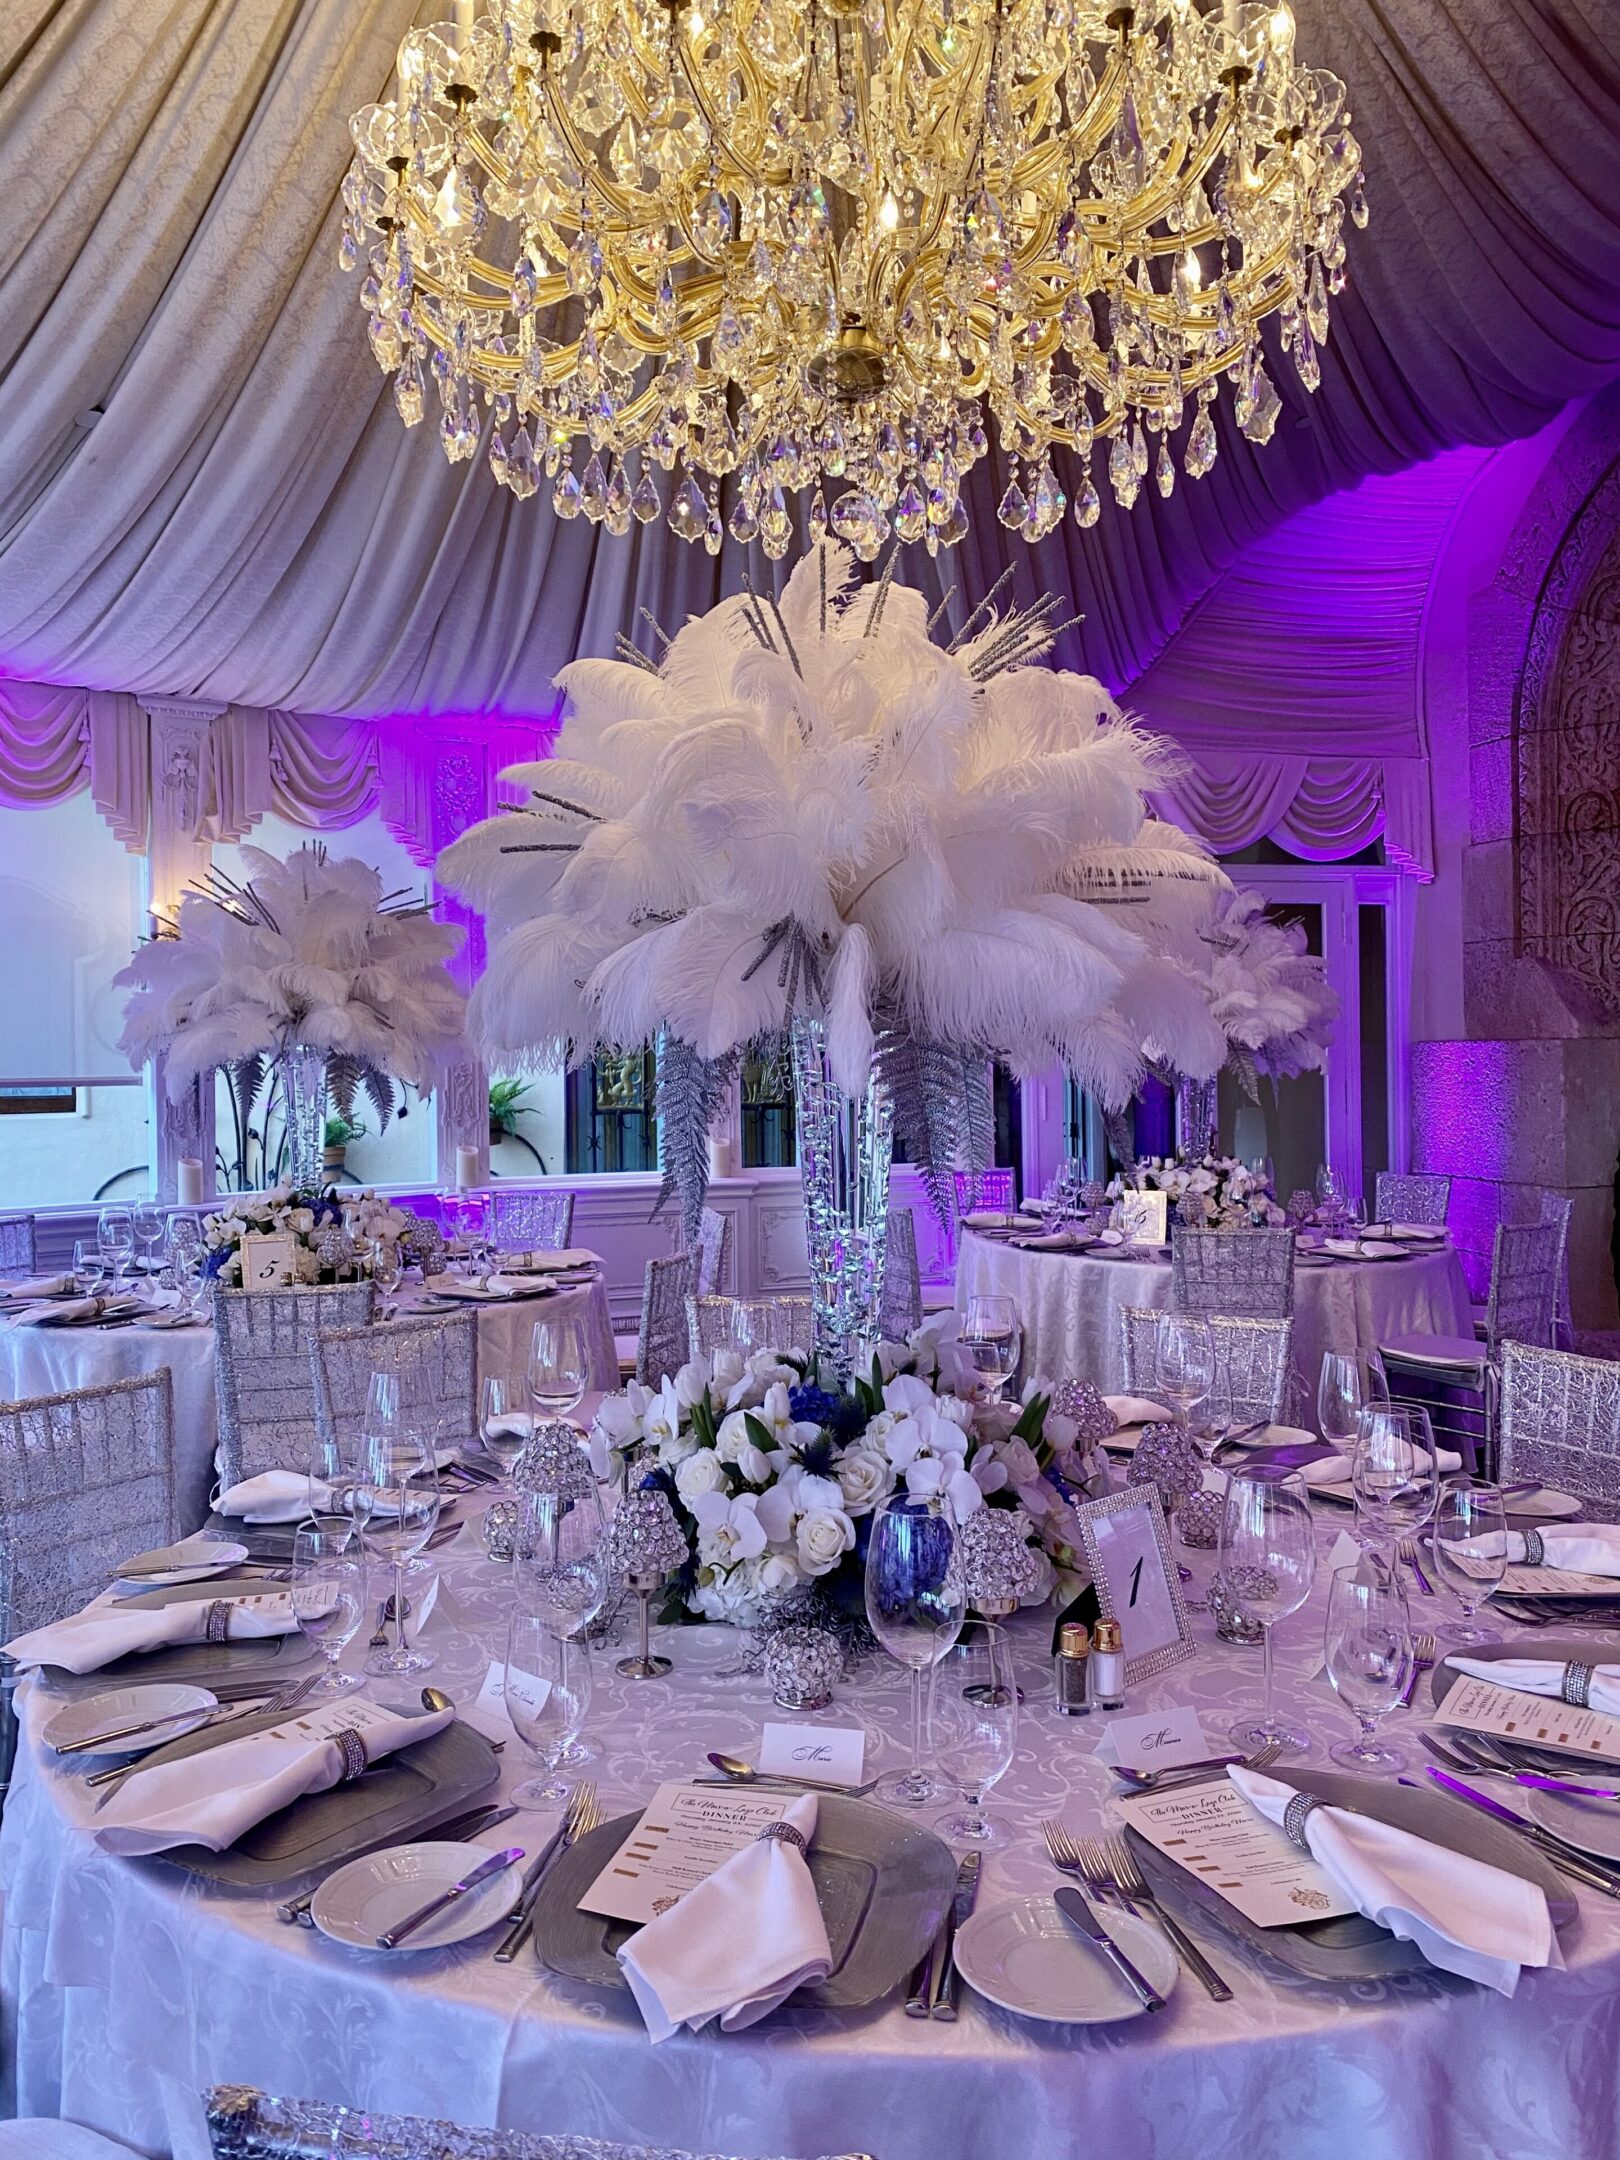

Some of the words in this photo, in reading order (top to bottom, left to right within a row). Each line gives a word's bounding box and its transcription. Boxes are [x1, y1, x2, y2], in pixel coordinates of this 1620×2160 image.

[259, 1260, 280, 1278] 5
[1130, 1556, 1143, 1608] 1
[1218, 1794, 1236, 1803] Club
[702, 1811, 747, 1821] DINNER
[756, 1806, 777, 1816] Club
[1181, 1808, 1223, 1820] DINNER
